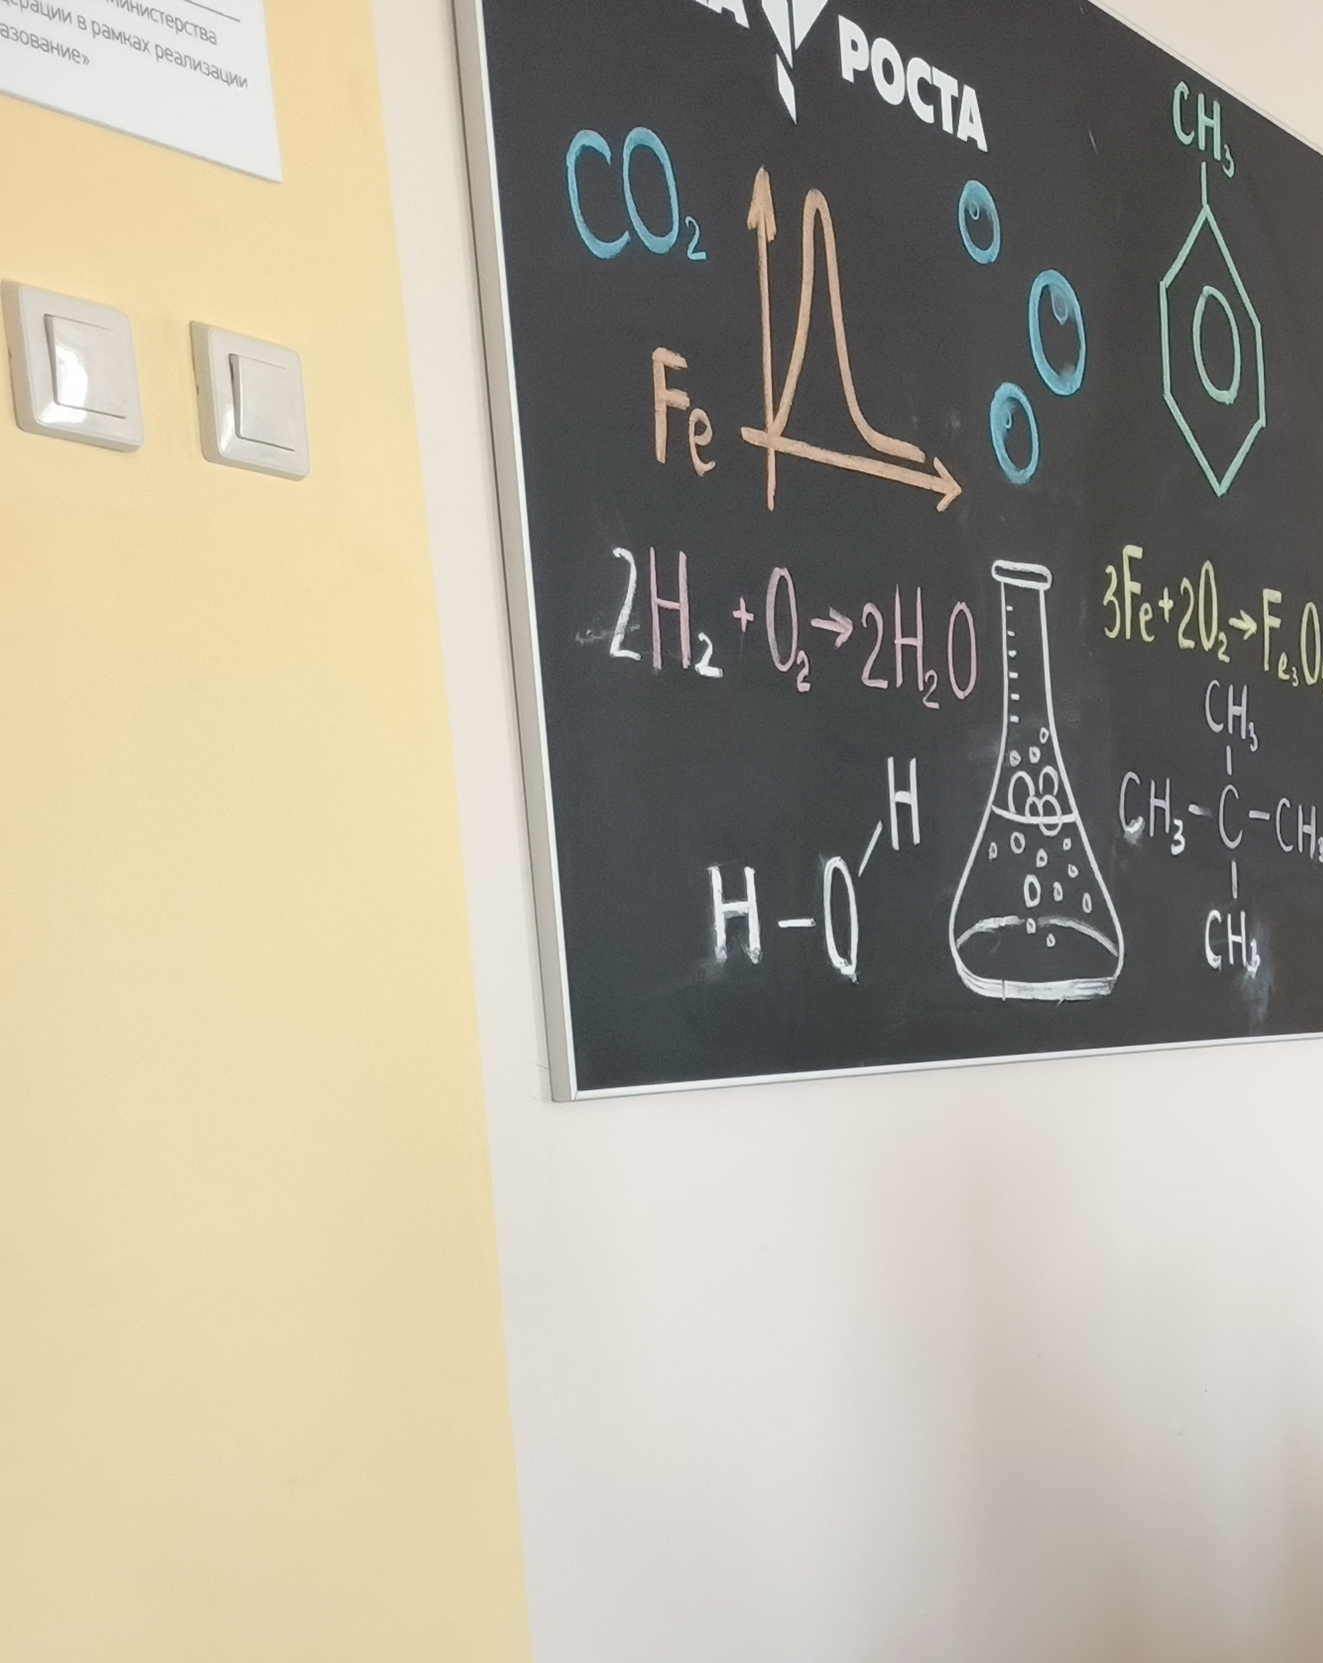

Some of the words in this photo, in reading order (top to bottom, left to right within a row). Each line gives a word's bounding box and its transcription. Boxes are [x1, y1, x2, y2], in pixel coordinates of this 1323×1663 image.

[77, 14, 88, 31] в
[91, 20, 151, 55] рамках
[154, 43, 248, 89] реализации
[105, 0, 217, 45] инистерства
[838, 14, 988, 153] РОСТА
[652, 347, 715, 476] Fe
[887, 756, 921, 851] H
